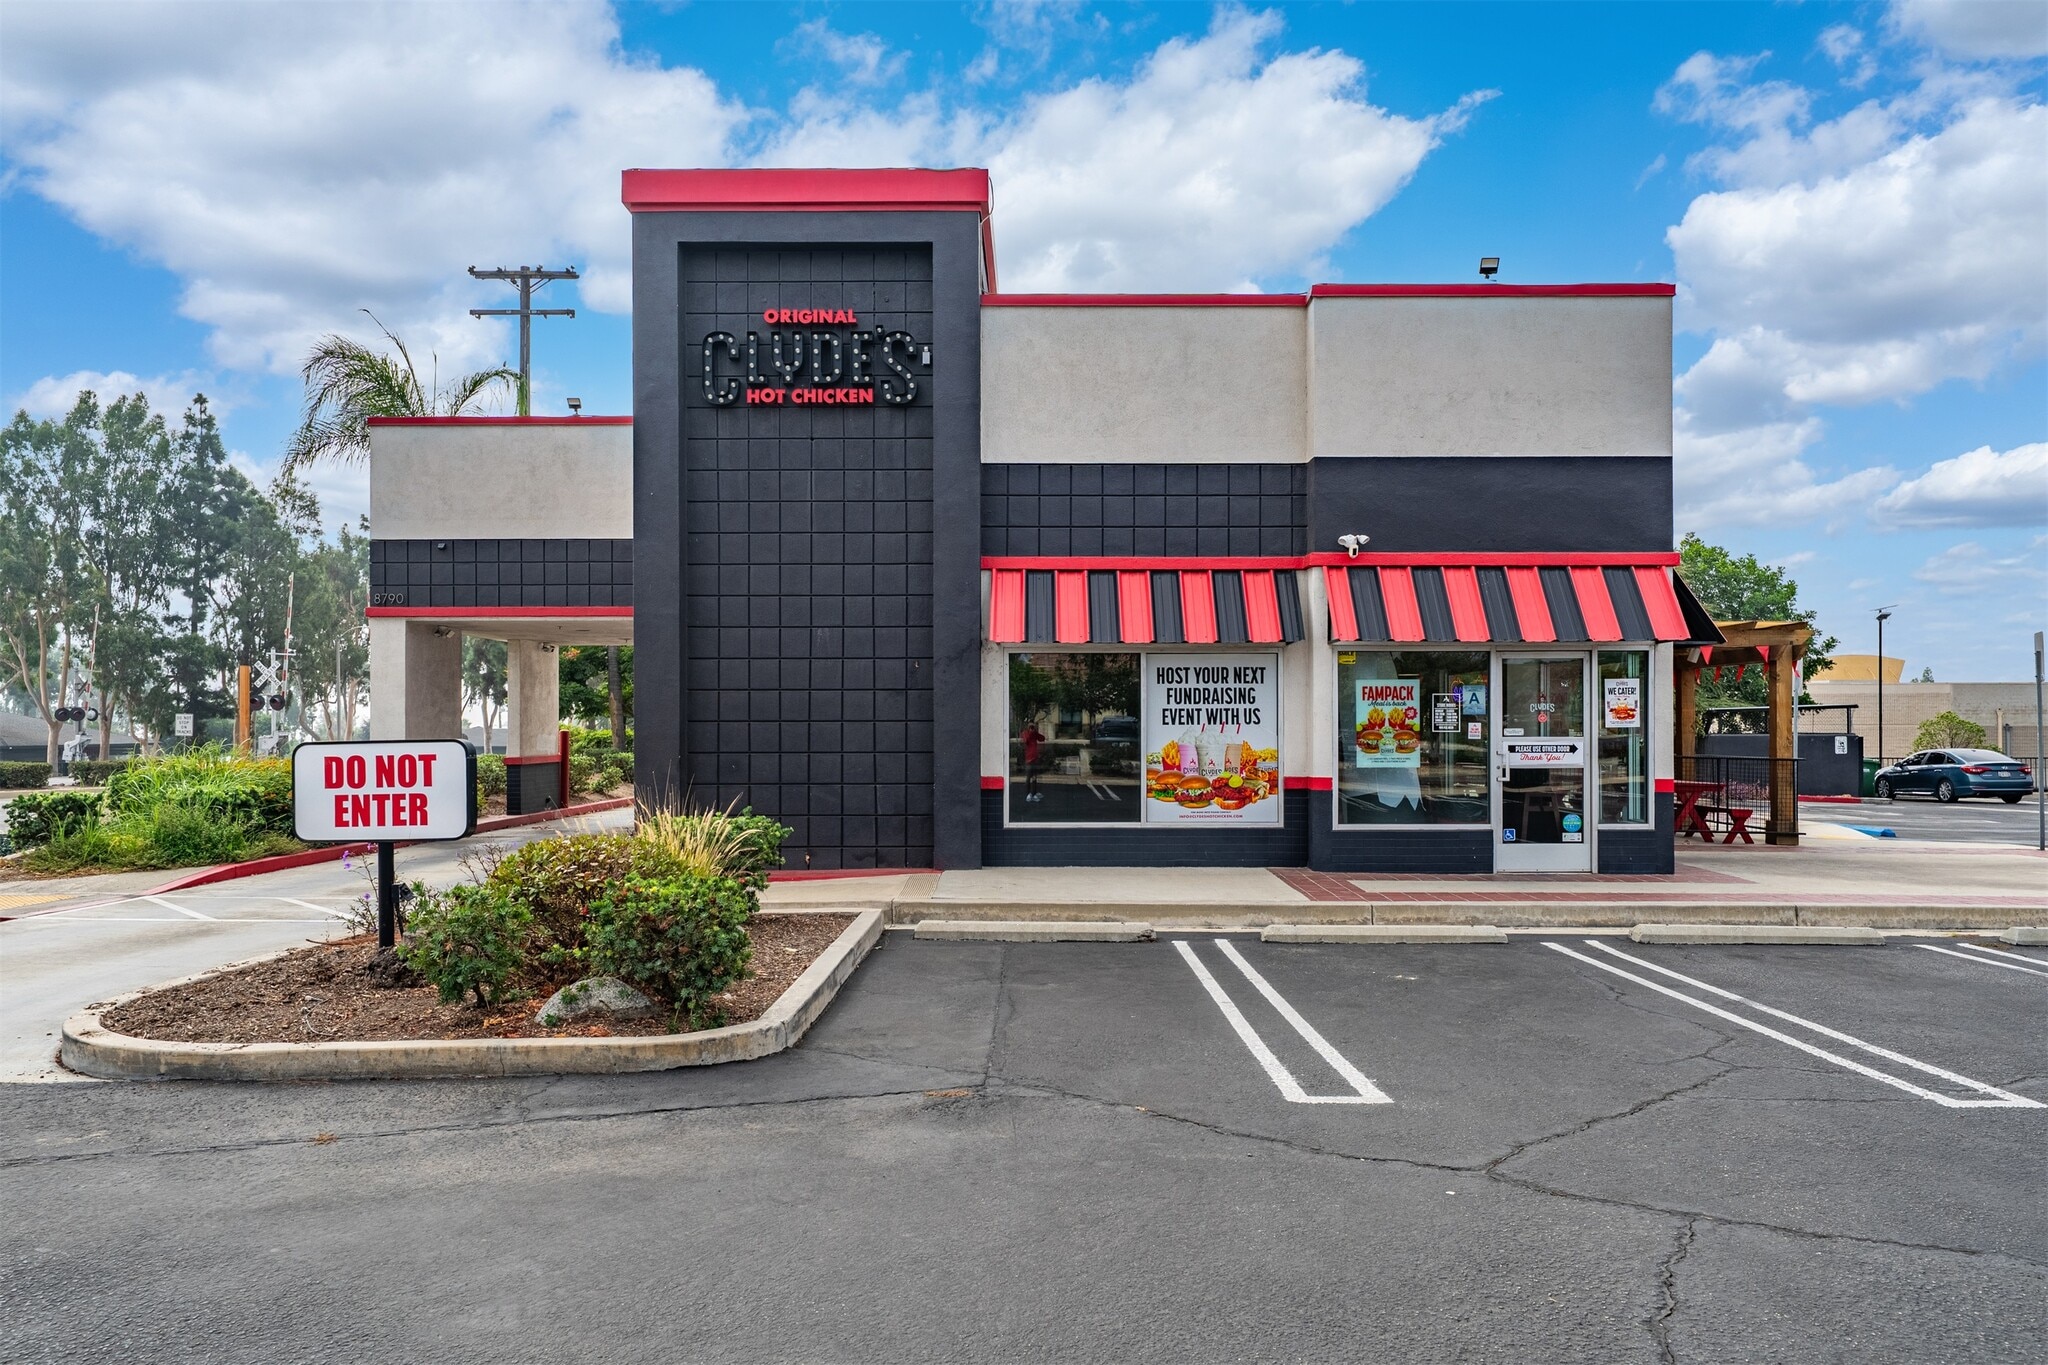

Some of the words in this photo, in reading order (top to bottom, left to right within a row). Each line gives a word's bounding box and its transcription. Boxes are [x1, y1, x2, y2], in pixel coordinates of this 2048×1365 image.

[763, 308, 857, 324] ORIGINAL
[702, 324, 918, 405] CLYDE'S
[746, 388, 786, 404] HOT
[791, 388, 874, 404] CHICKEN
[374, 593, 404, 604] 8790
[1156, 667, 1190, 684] HOST
[1194, 667, 1229, 684] YOUR
[1233, 667, 1266, 684] NEXT
[1166, 687, 1256, 705] FUNDRAISING
[1362, 686, 1414, 701] FAMPACK
[1469, 692, 1480, 704] A
[1607, 687, 1617, 695] WE
[1617, 687, 1637, 695] CATER!
[1162, 708, 1202, 725] EVENT
[1206, 708, 1240, 725] WITH
[1244, 708, 1261, 725] US
[1520, 753, 1543, 761] Thank
[1545, 753, 1566, 762] You!
[324, 755, 366, 789] DO
[375, 754, 437, 788] NOT
[334, 793, 428, 827] ENTER
